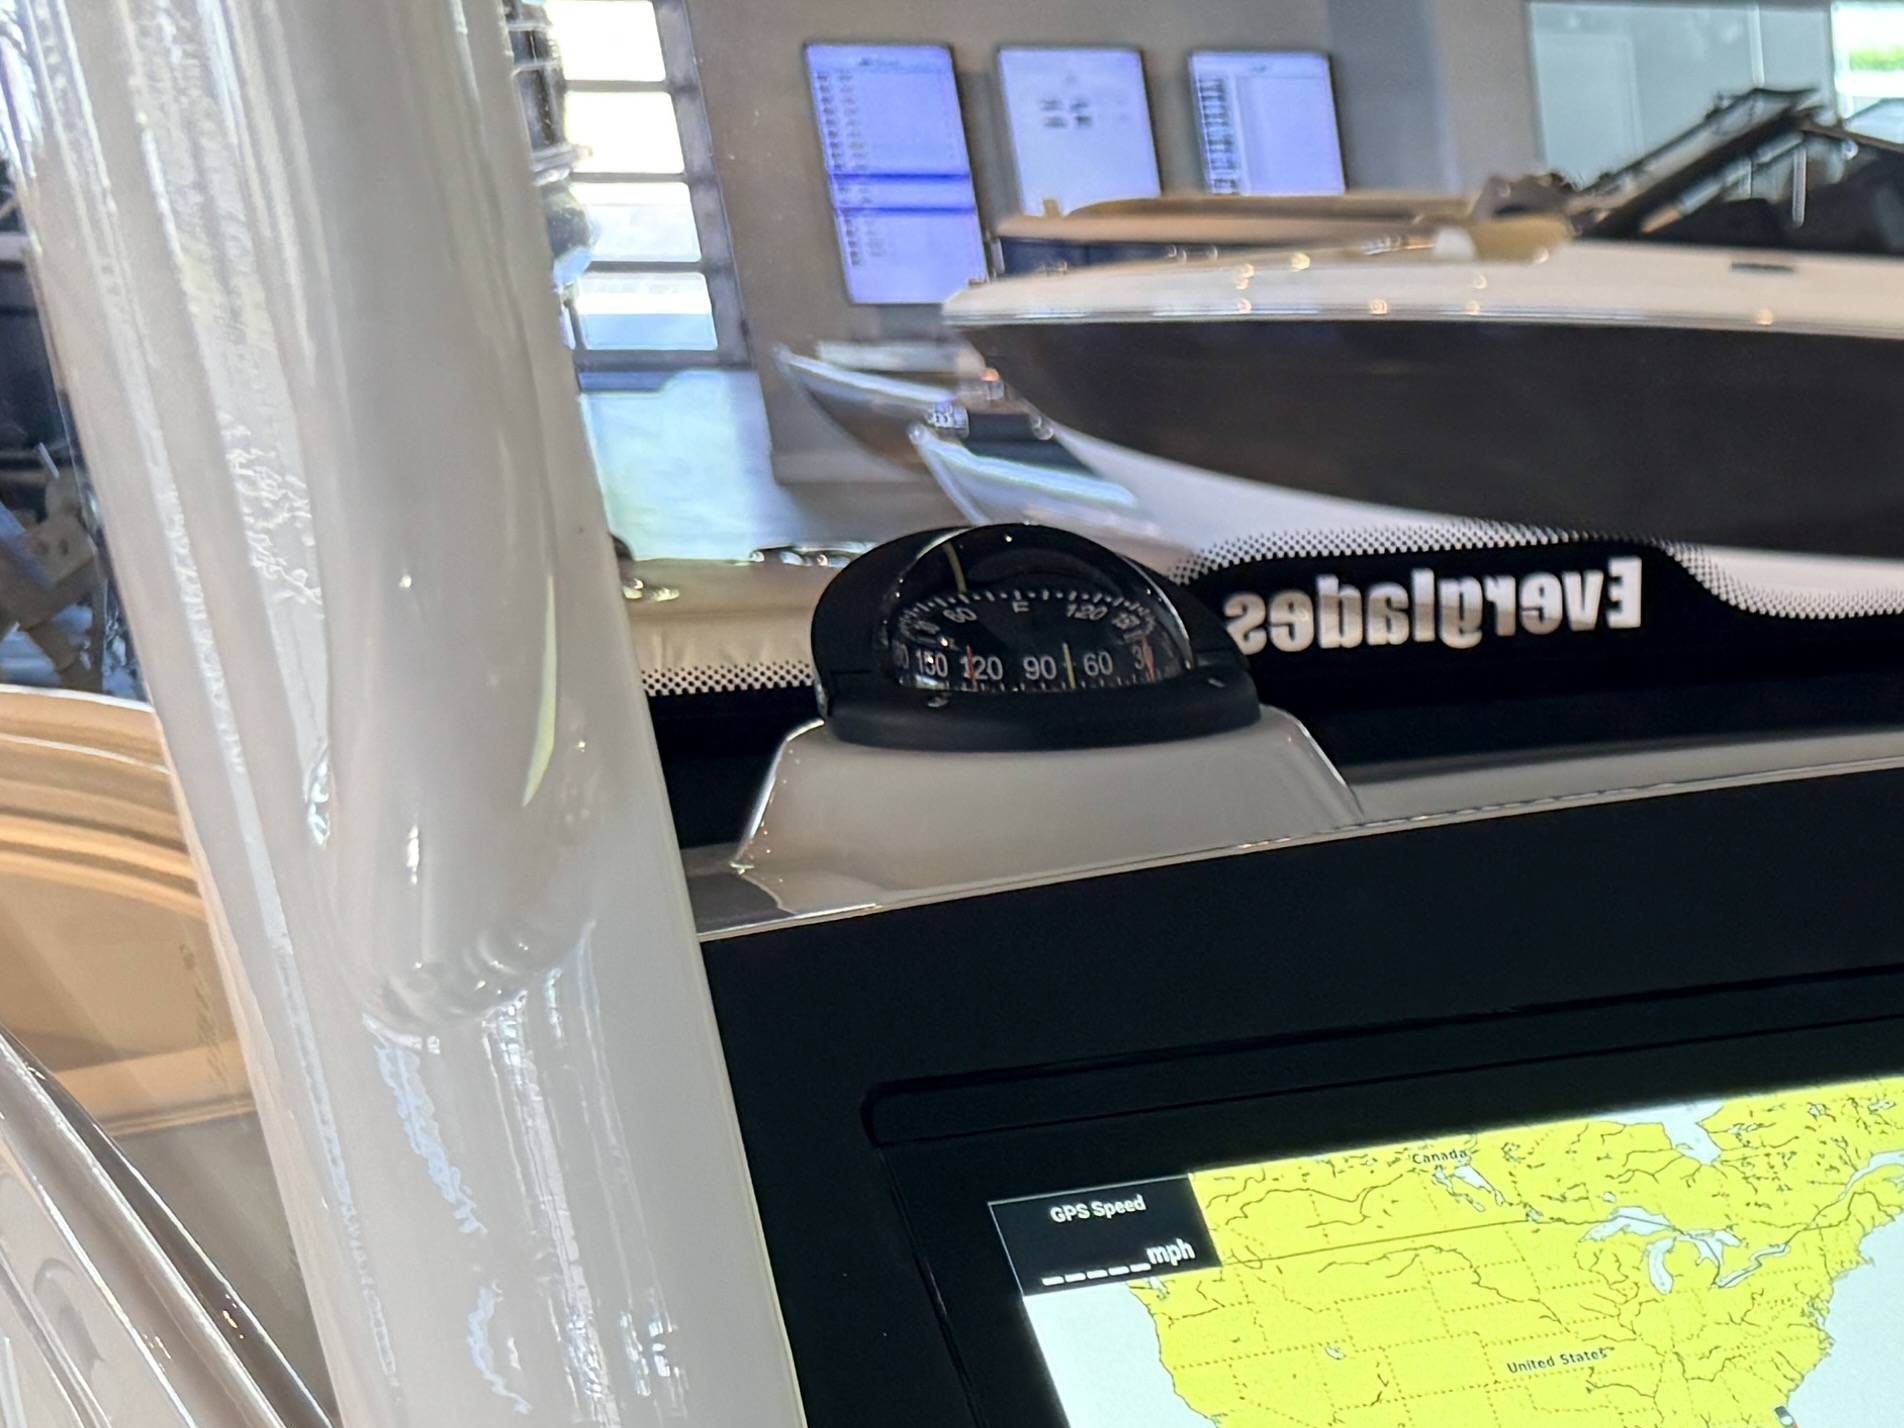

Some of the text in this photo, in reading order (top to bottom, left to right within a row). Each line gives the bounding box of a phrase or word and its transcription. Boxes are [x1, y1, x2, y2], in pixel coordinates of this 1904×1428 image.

[1024, 656, 1057, 680] 90
[1083, 651, 1113, 677] 60
[1412, 1149, 1468, 1165] Canada
[1050, 1194, 1147, 1223] GPS Speed
[1507, 1347, 1608, 1375] United States
